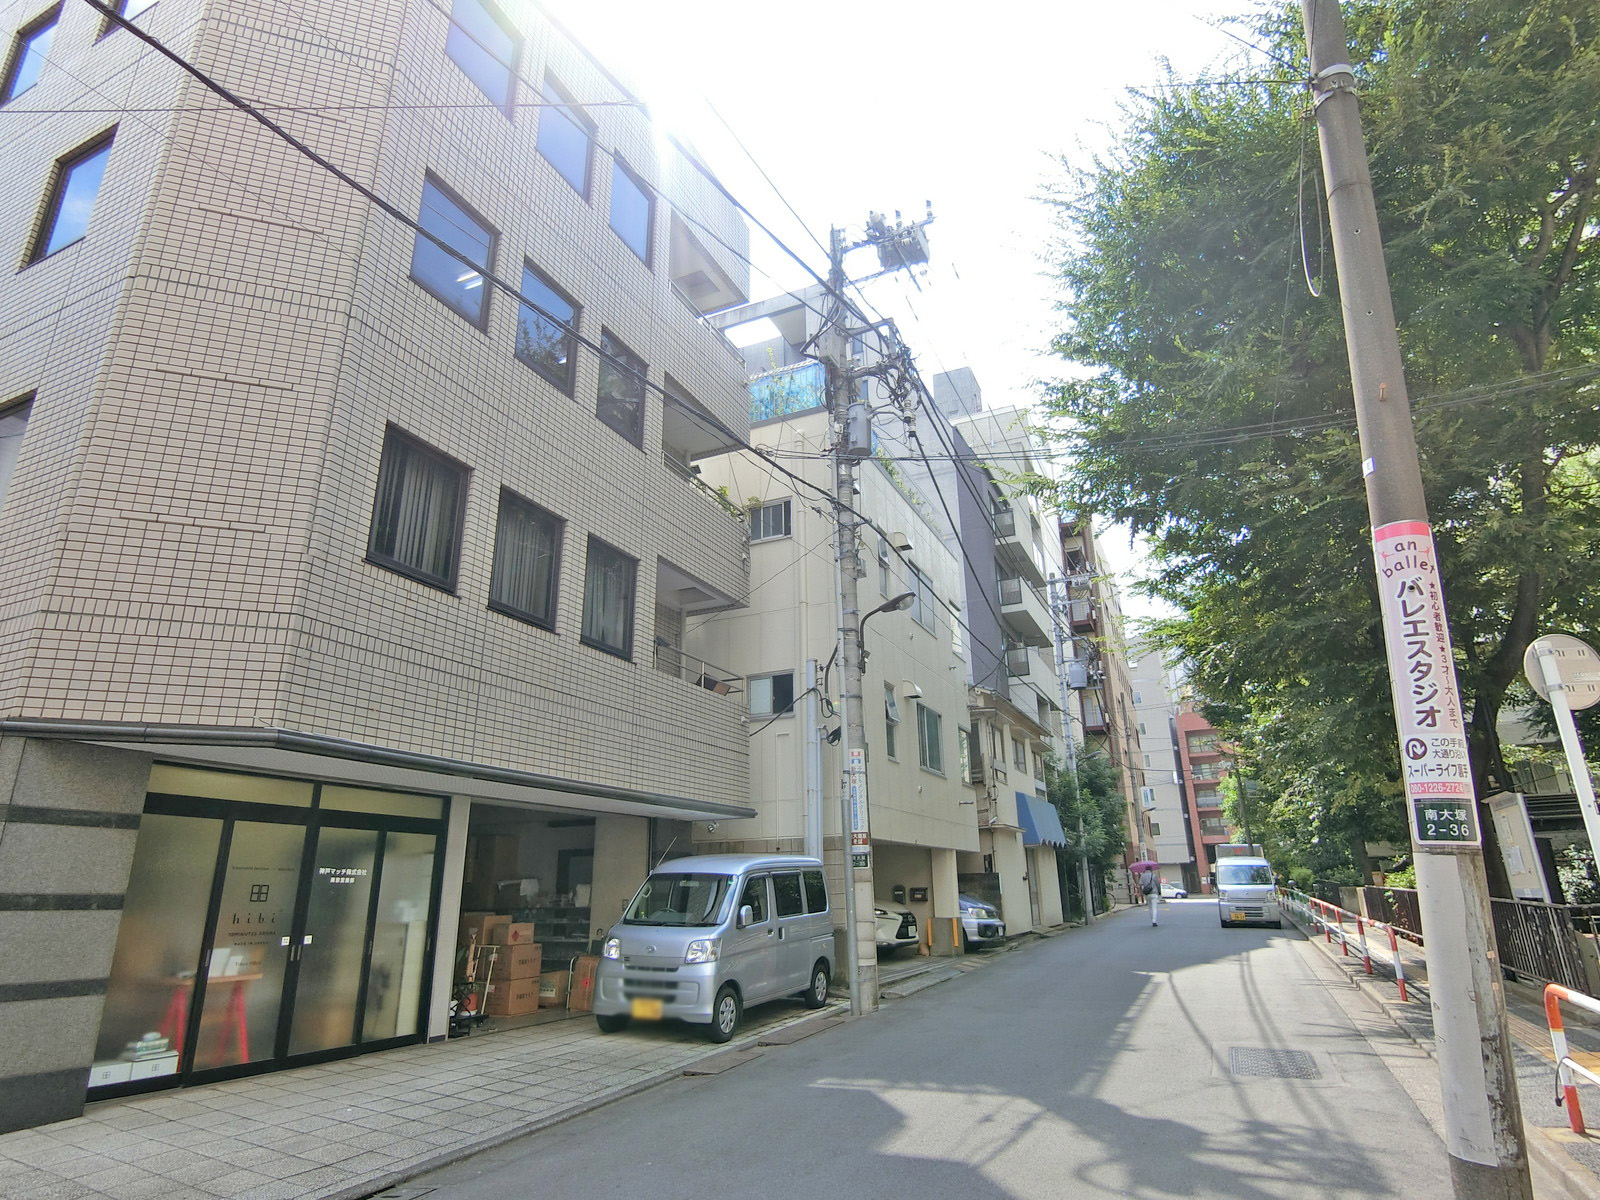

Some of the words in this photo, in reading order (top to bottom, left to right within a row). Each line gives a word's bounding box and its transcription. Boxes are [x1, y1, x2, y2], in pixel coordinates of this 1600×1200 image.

[1394, 540, 1417, 553] an
[1397, 576, 1441, 728] バレエスタジオ
[1424, 809, 1468, 821] 南大塚
[1427, 824, 1470, 836] 2-36
[232, 912, 276, 925] hibi
